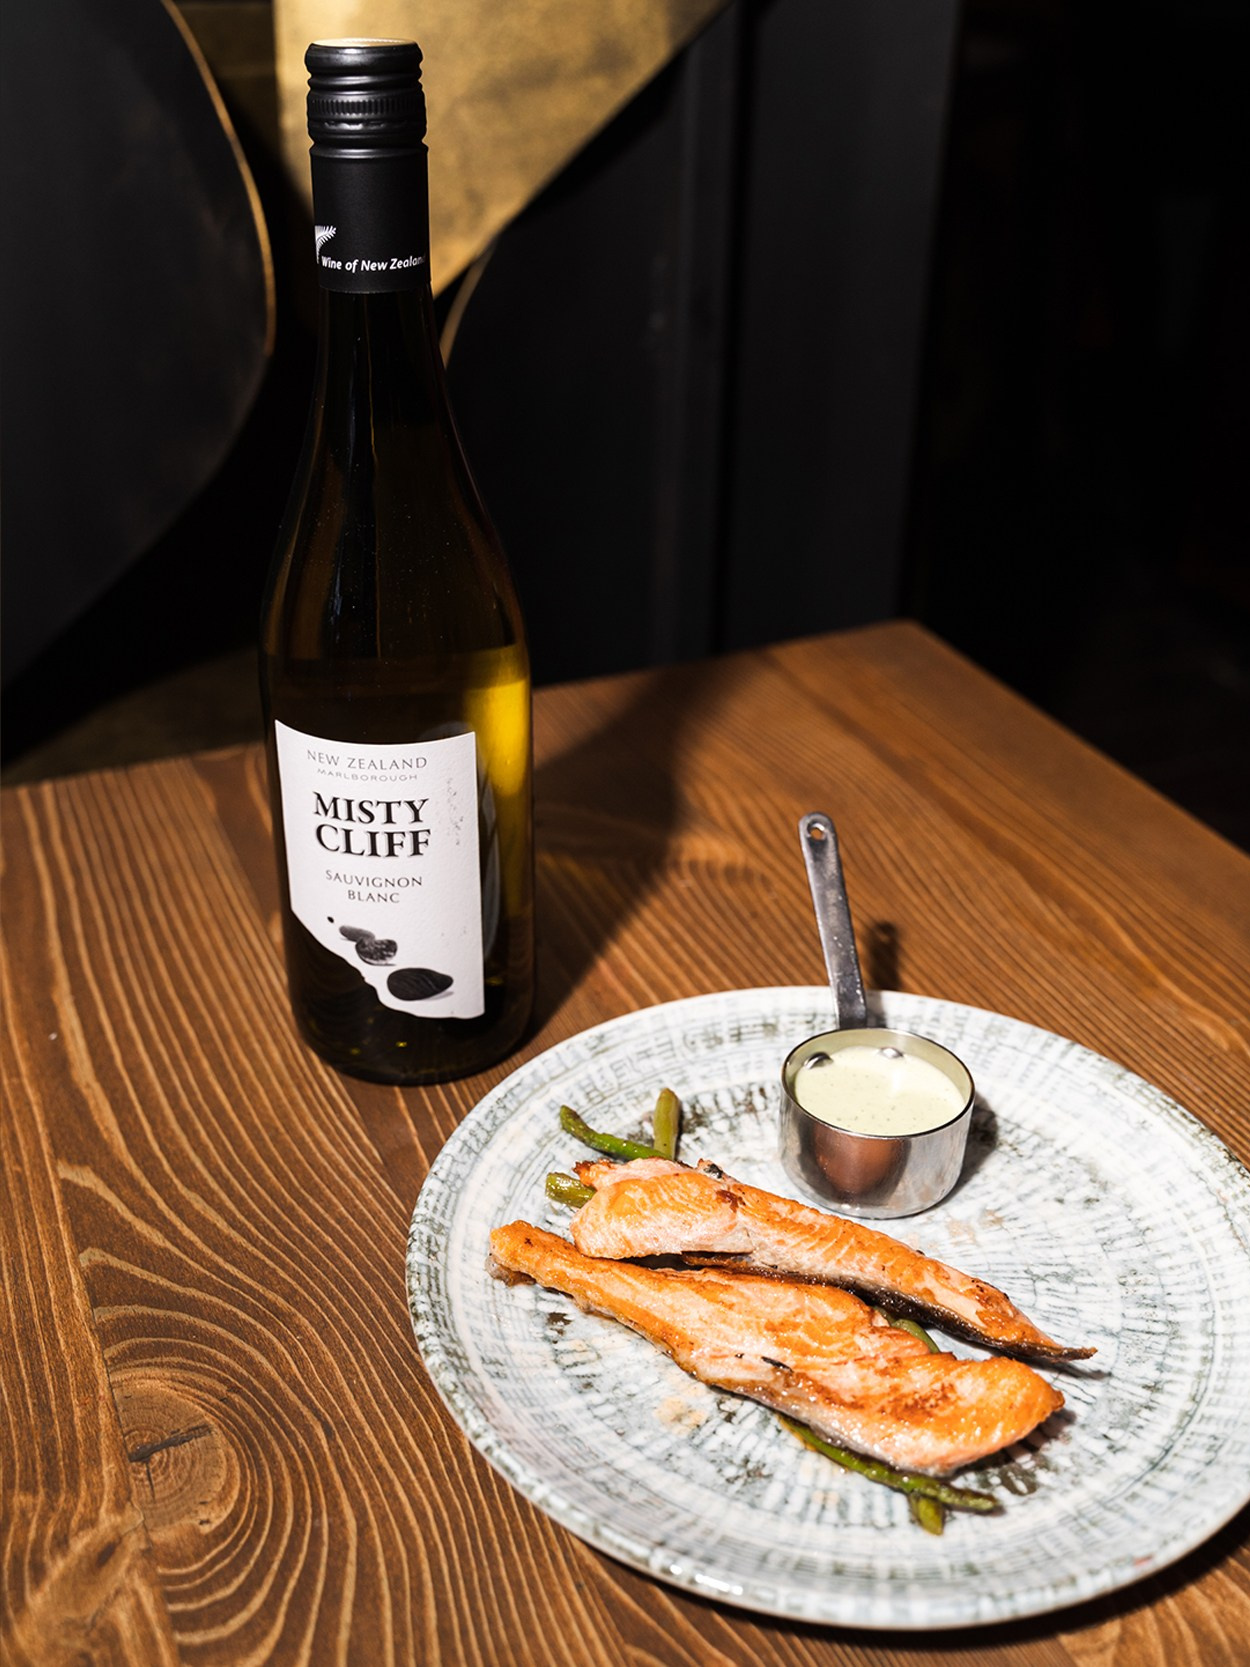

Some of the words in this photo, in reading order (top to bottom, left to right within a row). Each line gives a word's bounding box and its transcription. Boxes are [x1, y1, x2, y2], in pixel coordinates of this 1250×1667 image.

[321, 256, 342, 270] Wine
[345, 259, 358, 273] of
[361, 260, 387, 271] New
[307, 750, 339, 766] NEW
[347, 757, 427, 770] ZEALAND
[317, 768, 418, 781] MARLBOROUGH
[313, 791, 430, 824] MISTY
[316, 824, 431, 857] CLIFF
[325, 869, 423, 888] SAUVIGNON
[347, 890, 400, 904] BLANC
